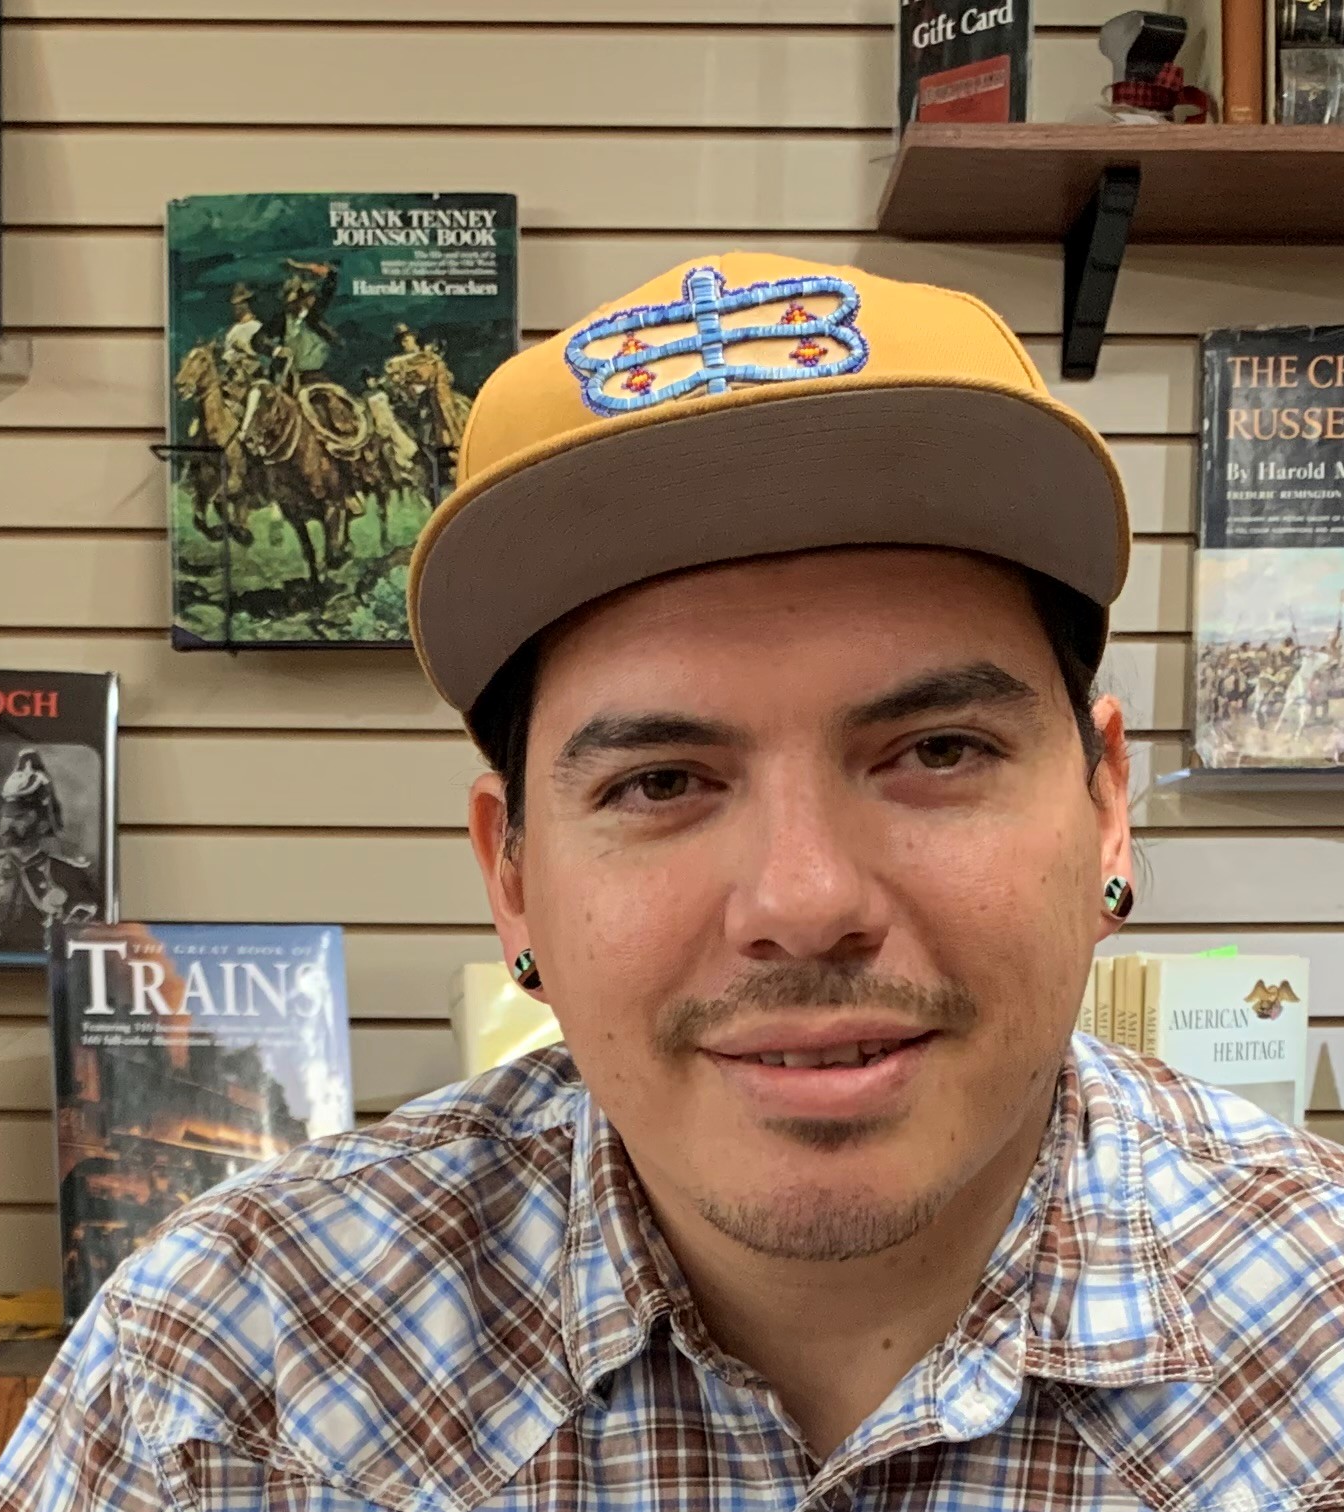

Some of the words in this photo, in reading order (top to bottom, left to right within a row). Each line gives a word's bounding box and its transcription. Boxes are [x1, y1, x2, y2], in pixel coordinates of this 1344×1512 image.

[912, 13, 956, 49] Gift
[960, 0, 1014, 35] Card
[329, 209, 403, 228] FRANK
[407, 209, 497, 228] TENNEY
[332, 228, 430, 246] JOHNSON
[437, 228, 497, 246] BOOK
[352, 279, 406, 296] Harold
[411, 279, 499, 296] McCracken
[1226, 356, 1299, 389] THE
[1226, 462, 1252, 483] By
[1258, 461, 1325, 481] Harold
[132, 943, 164, 954] THE
[173, 944, 228, 955] GREAT
[67, 940, 325, 1019] TRAINS
[1168, 1007, 1249, 1031] AMERICAN
[1213, 1040, 1285, 1062] HERITAGE
